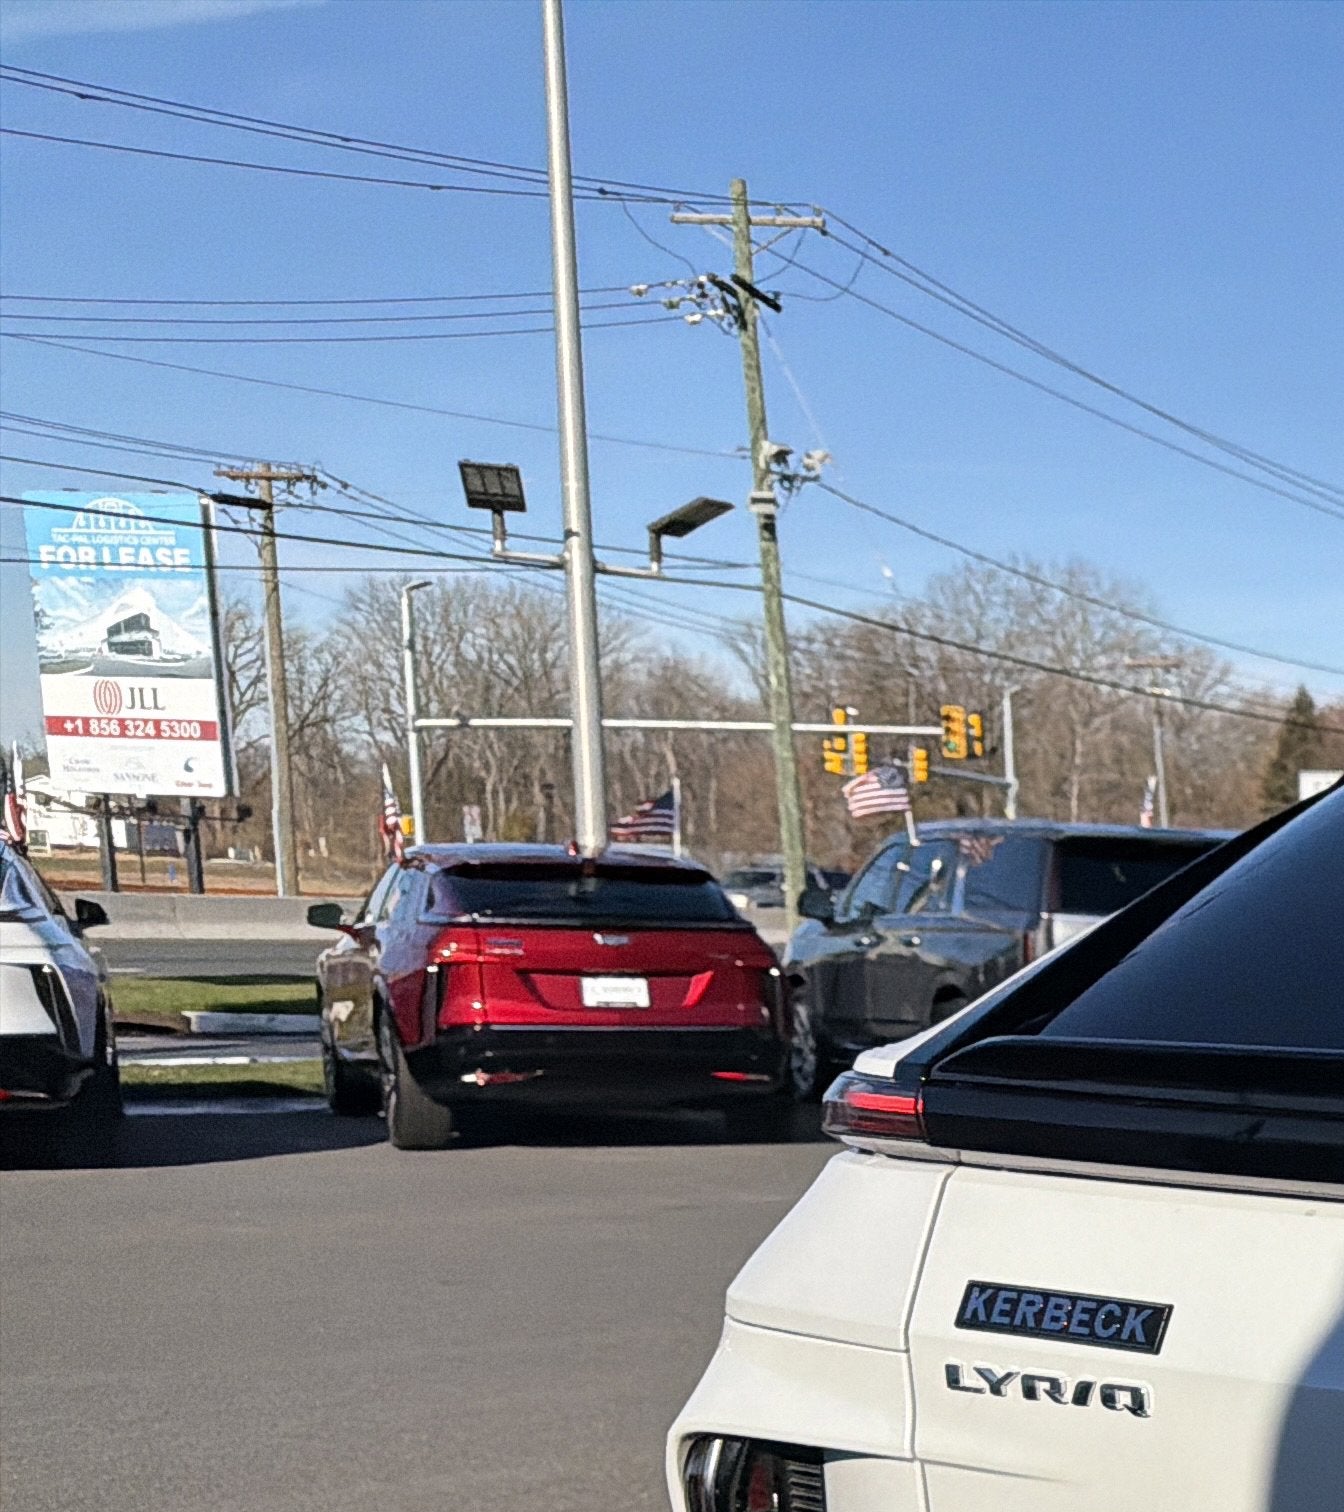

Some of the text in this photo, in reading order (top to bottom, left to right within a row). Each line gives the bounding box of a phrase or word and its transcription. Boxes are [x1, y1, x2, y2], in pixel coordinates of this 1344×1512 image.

[39, 544, 193, 573] FOR LEASE
[126, 687, 166, 711] JLL
[64, 718, 202, 739] +1 856 324 5300
[963, 1286, 1155, 1343] KERBECK
[944, 1362, 1152, 1419] LYRIQ
